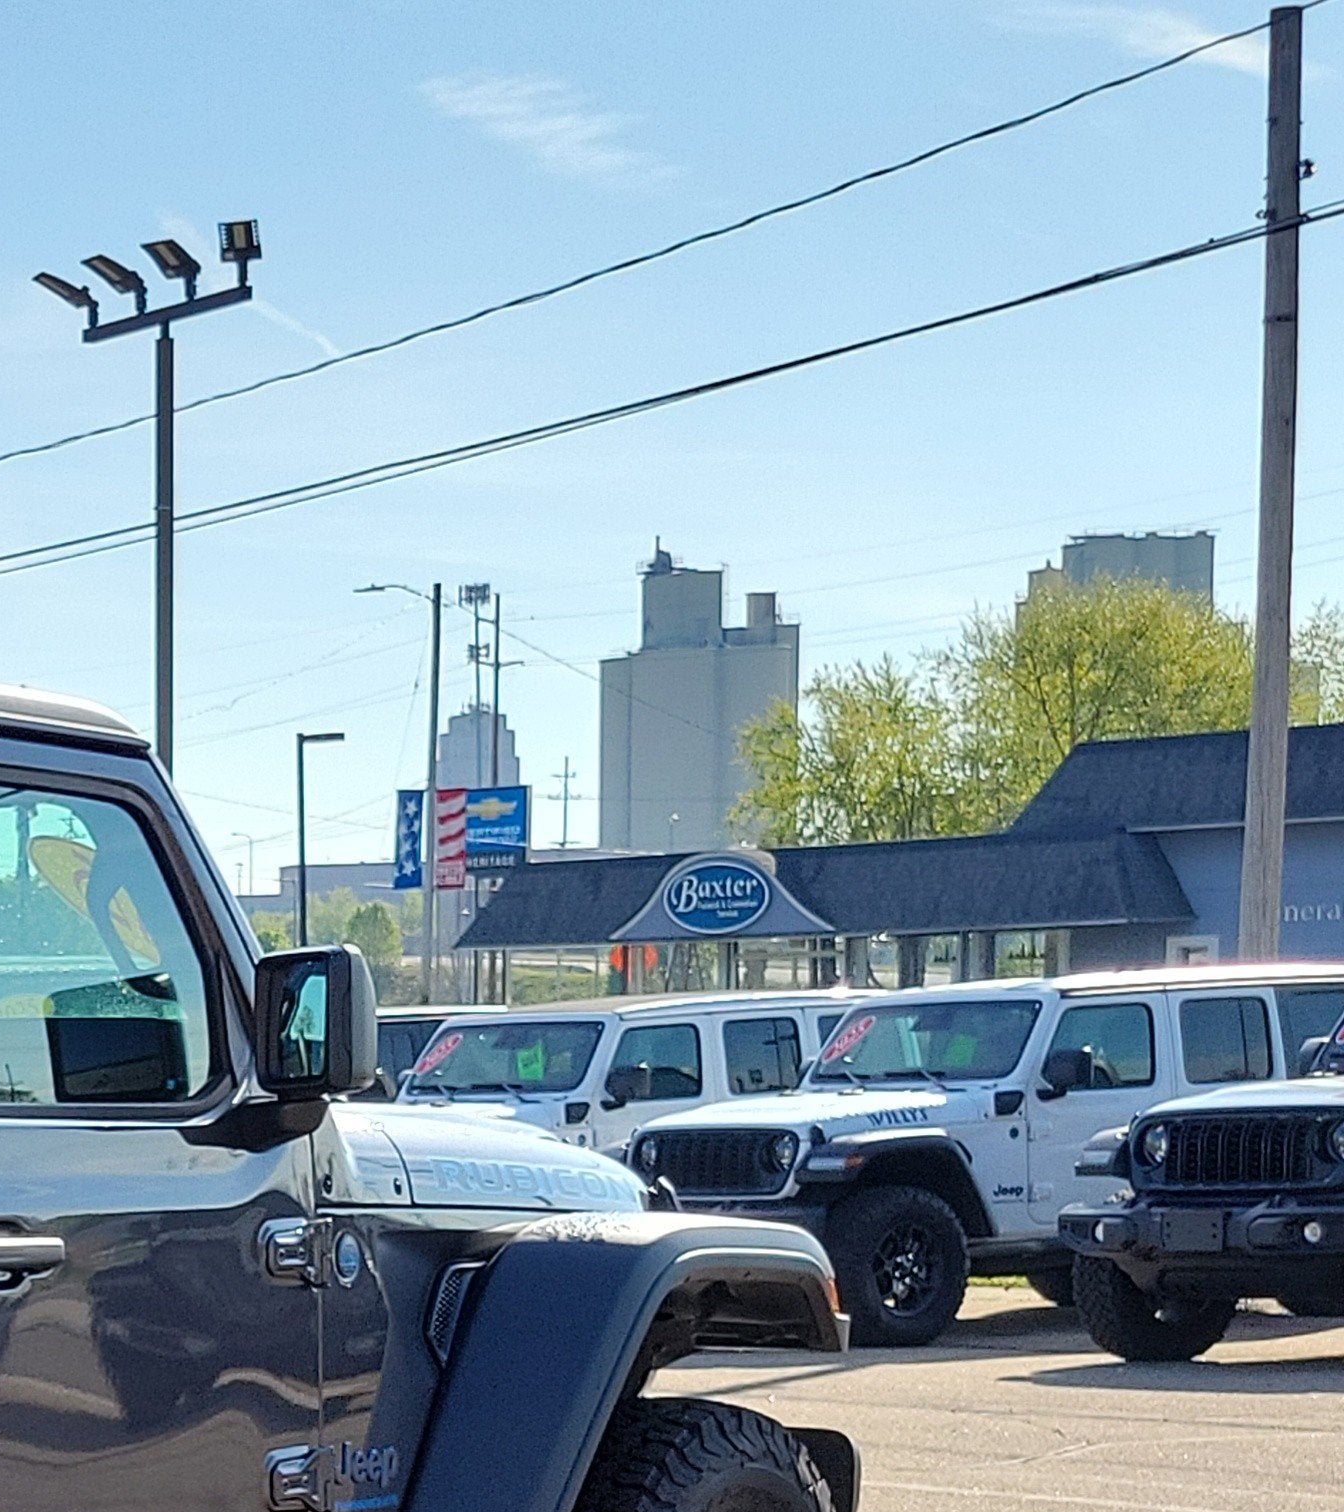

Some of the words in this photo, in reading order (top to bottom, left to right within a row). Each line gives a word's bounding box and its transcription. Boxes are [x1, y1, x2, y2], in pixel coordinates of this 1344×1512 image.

[671, 875, 758, 913] Baxter
[867, 1107, 929, 1127] WILLYS
[428, 1158, 638, 1204] RUBICON
[992, 1184, 1024, 1198] Jeep
[334, 1440, 399, 1488] Jeep
